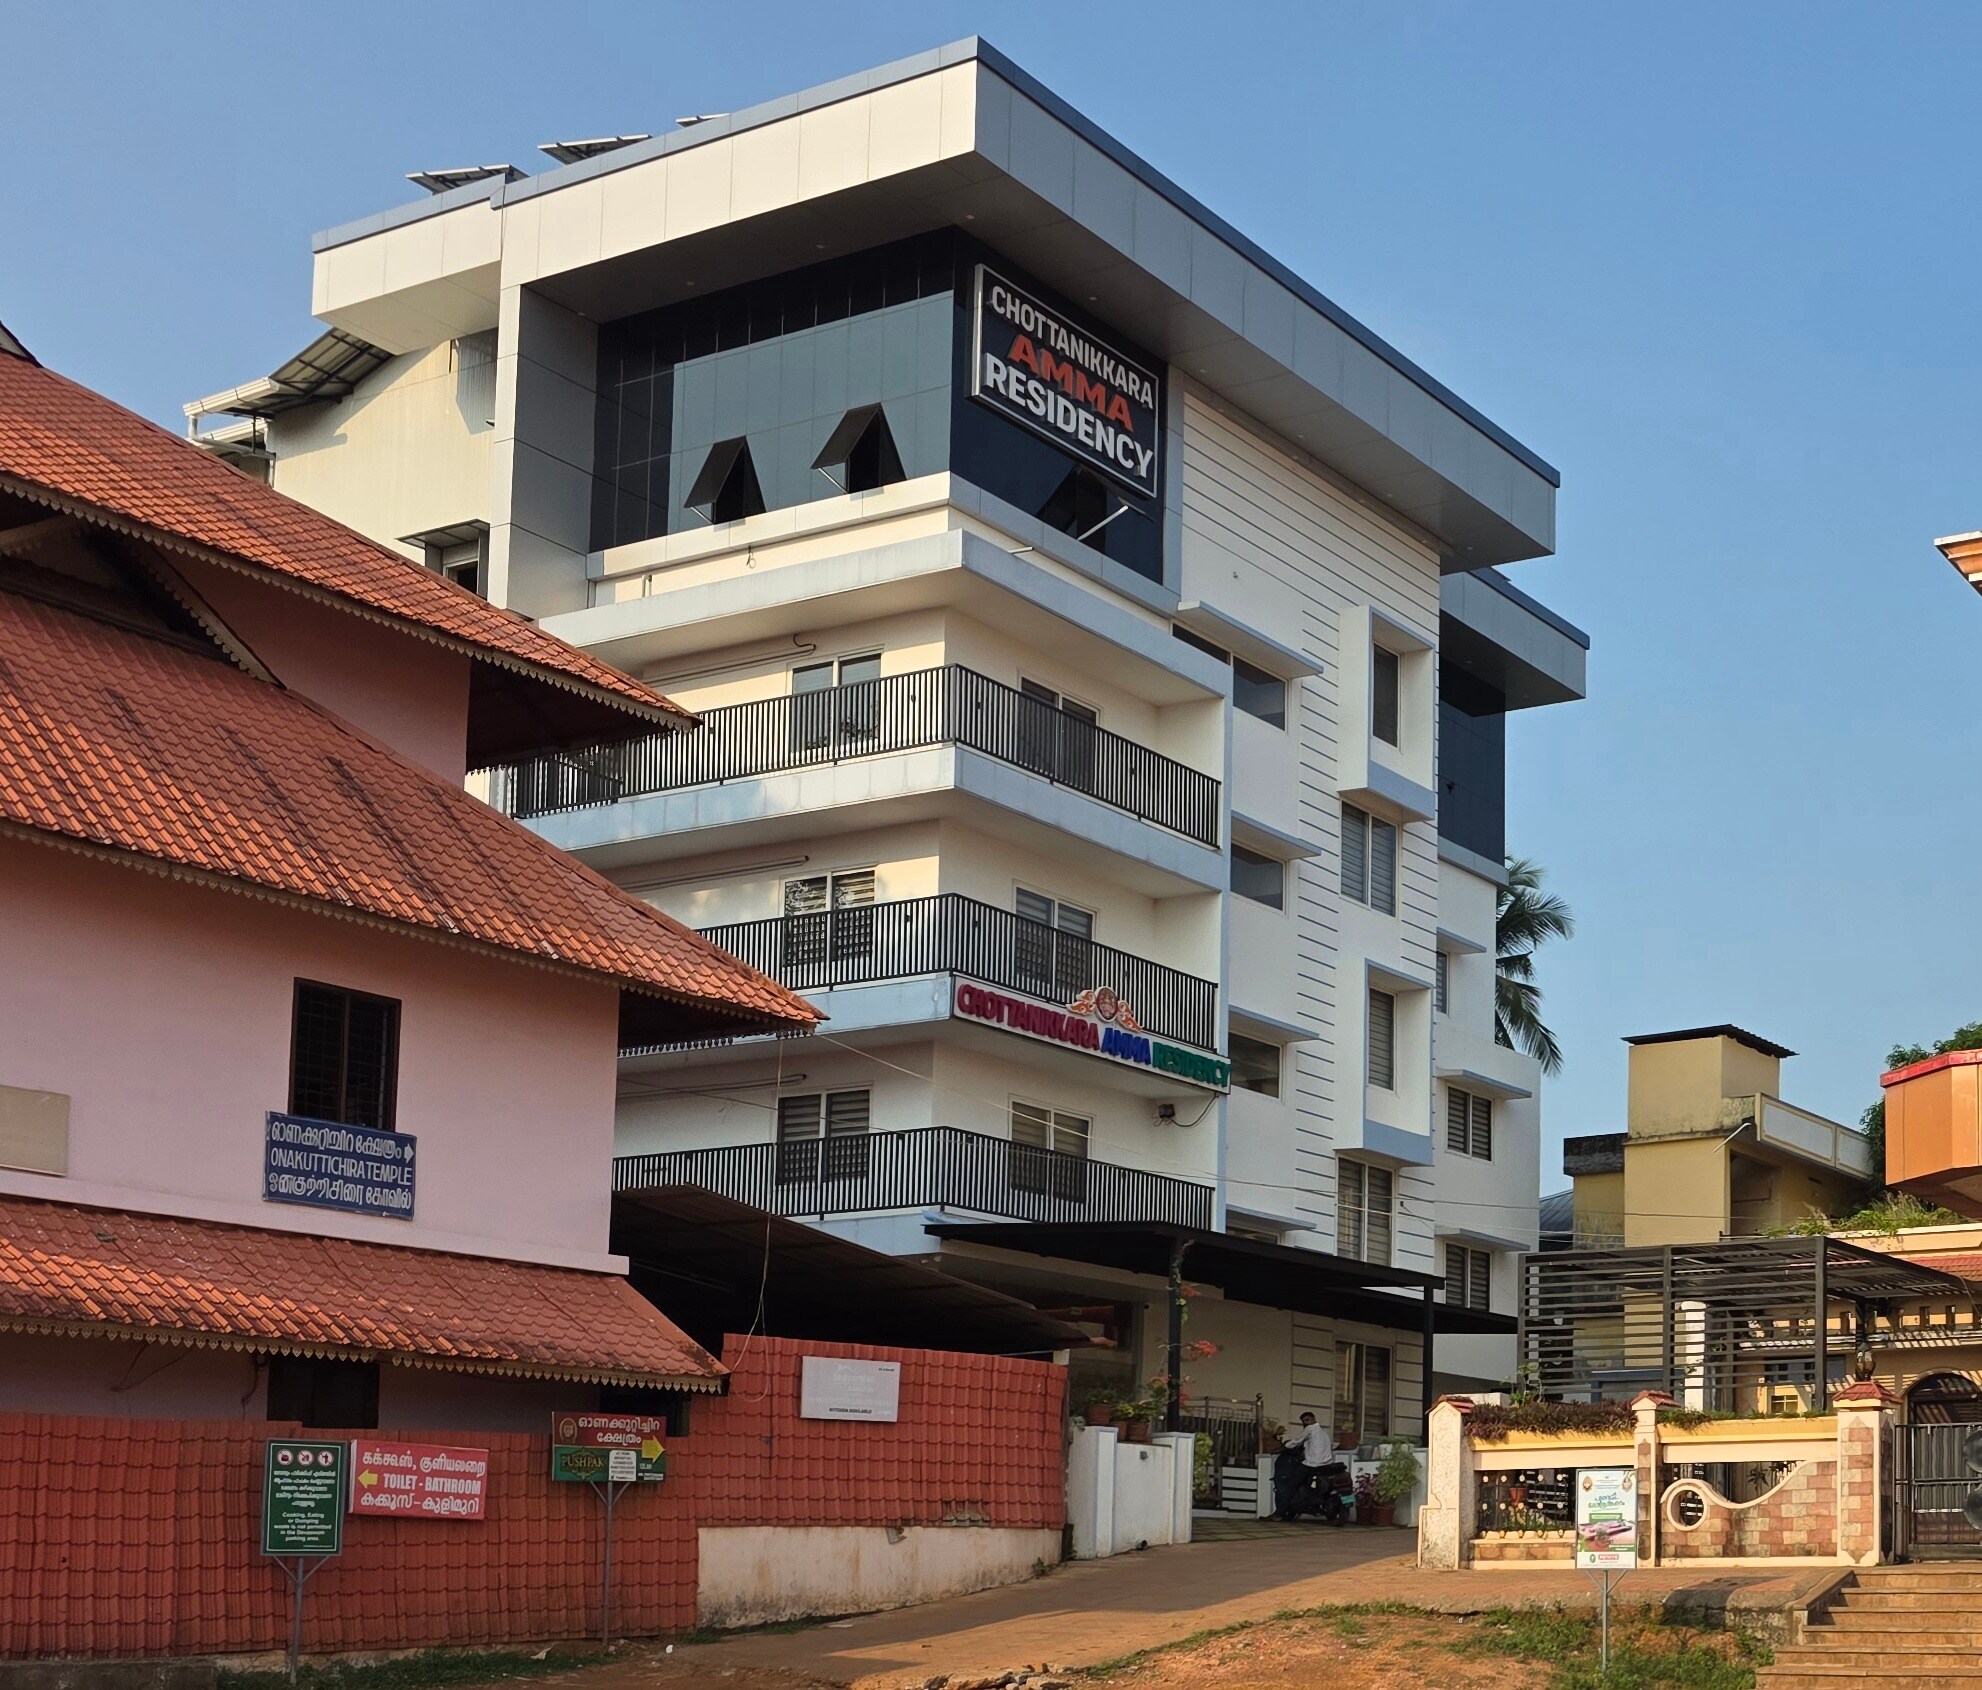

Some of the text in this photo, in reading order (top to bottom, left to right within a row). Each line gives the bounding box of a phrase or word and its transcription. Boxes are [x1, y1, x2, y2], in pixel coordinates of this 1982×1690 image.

[991, 285, 1154, 410] CHOTTANIKKARA
[1008, 333, 1134, 433] AMMA
[985, 352, 1154, 479] RESIDENCY
[957, 983, 1231, 1088] CHOTTANIKKARA AMMA RESIDENCY
[270, 1147, 413, 1186] ONAKUTTICHIRA TEMPLE
[383, 1473, 418, 1490] TOILET
[425, 1476, 482, 1495] BATHROOM
[561, 1455, 605, 1468] PUSHPAK
